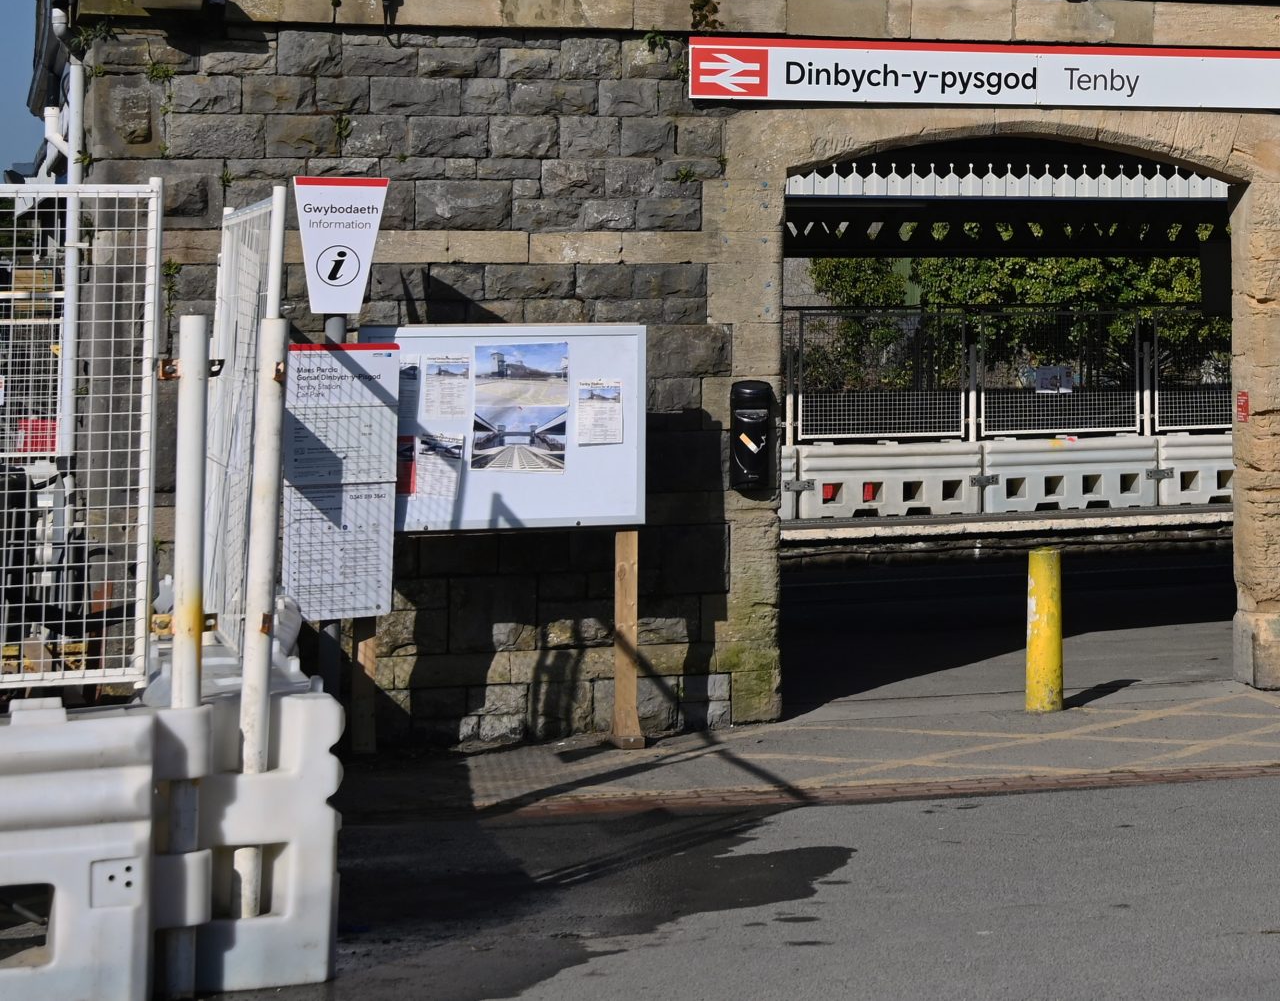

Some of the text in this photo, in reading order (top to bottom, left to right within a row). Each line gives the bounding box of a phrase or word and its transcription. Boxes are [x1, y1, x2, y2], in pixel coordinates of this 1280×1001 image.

[785, 61, 1140, 98] Dinbych-y-pysgod Tenby
[303, 203, 379, 216] Gwybodaeth
[308, 219, 372, 230] Information
[296, 366, 315, 374] Maes
[296, 383, 316, 391] Tenby
